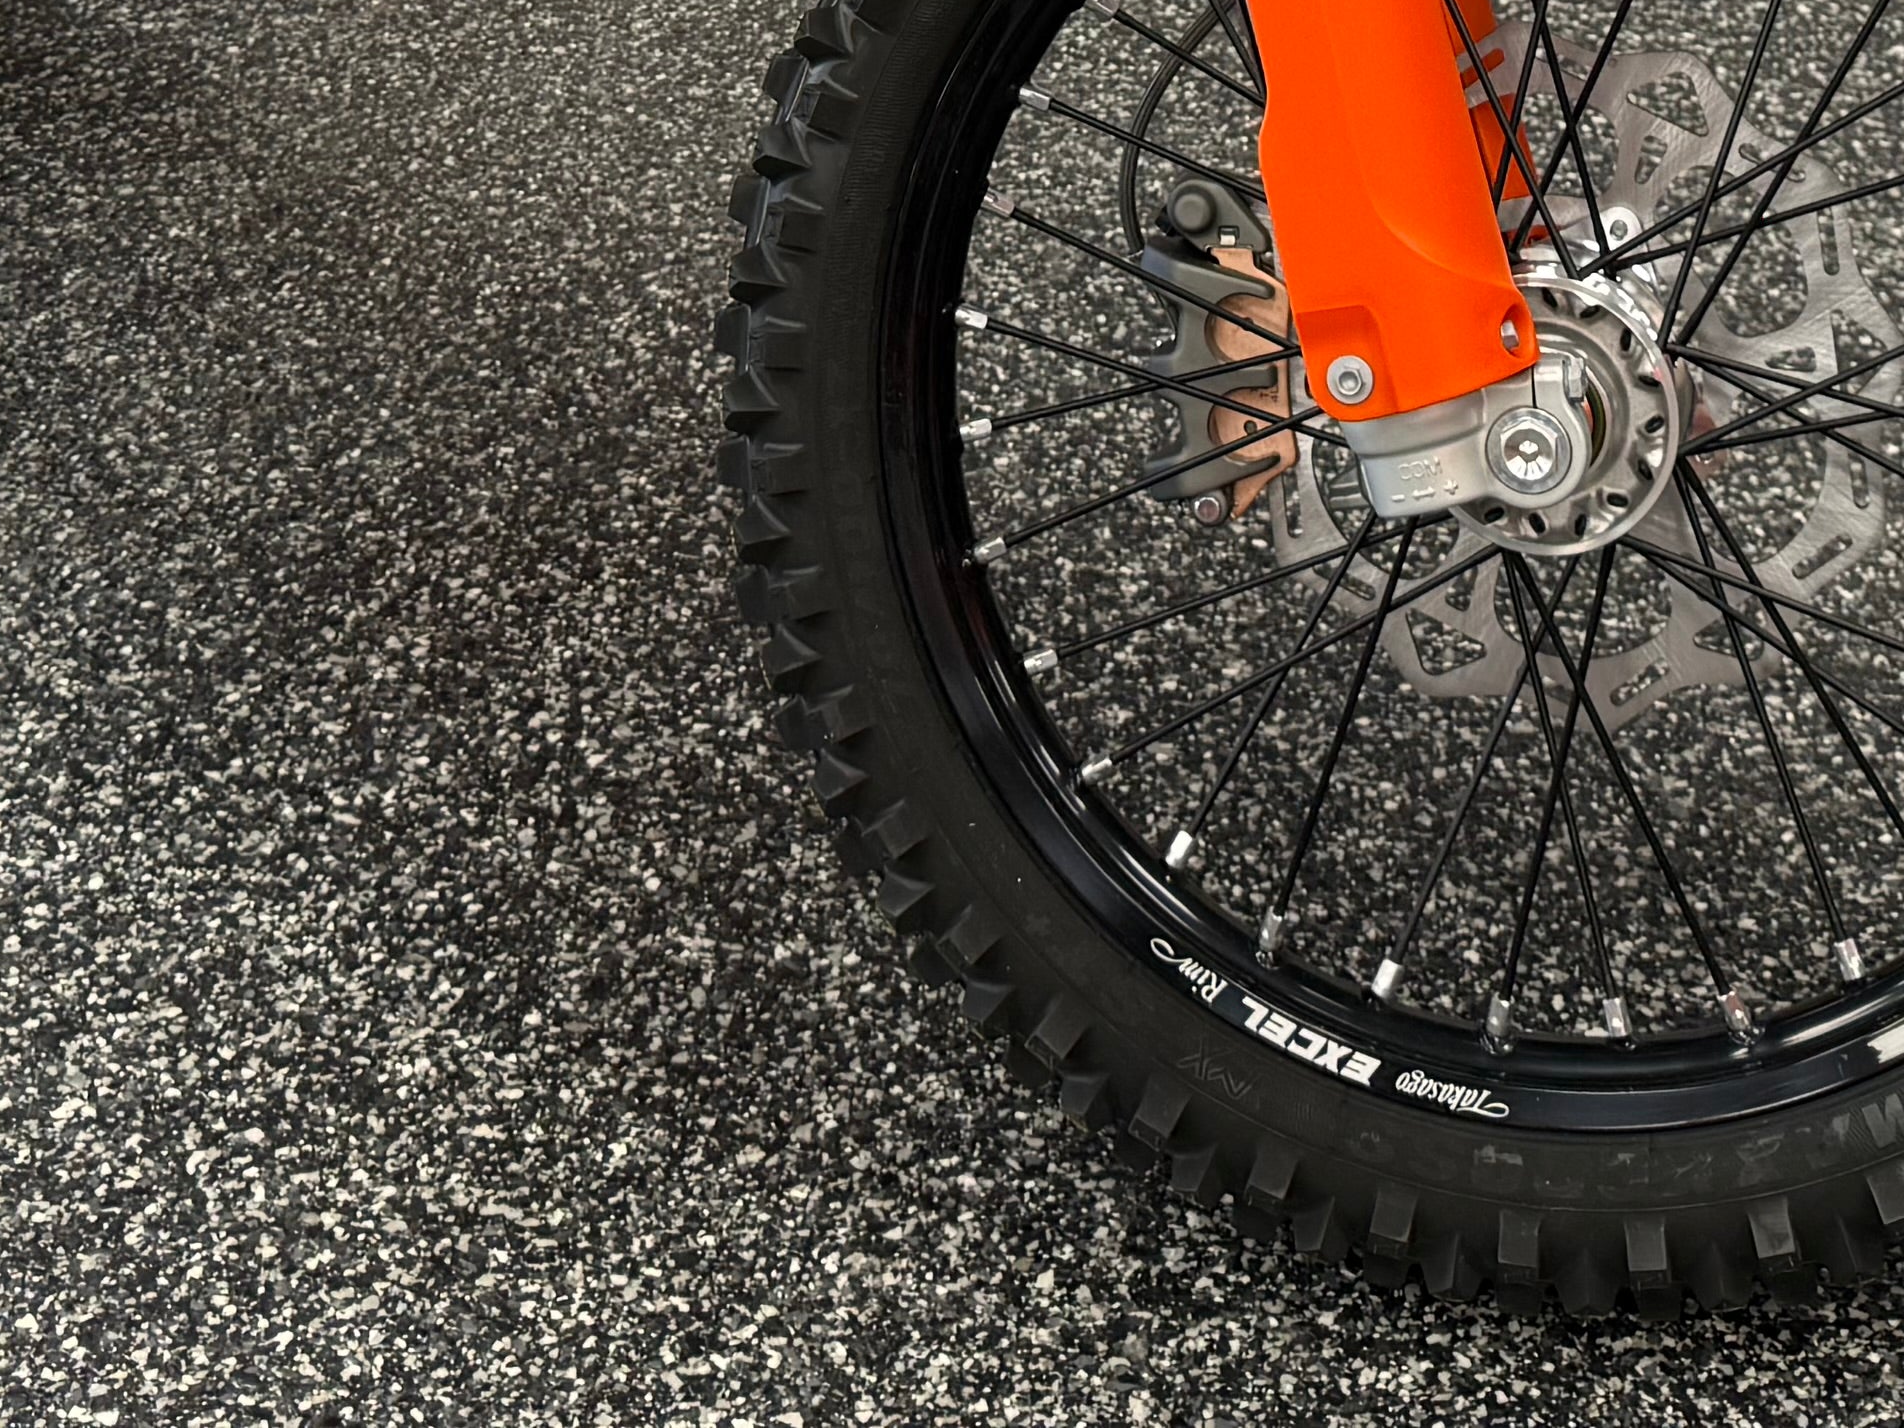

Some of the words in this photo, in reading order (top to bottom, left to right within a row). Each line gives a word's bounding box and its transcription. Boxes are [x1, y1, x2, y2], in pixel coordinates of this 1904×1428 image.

[1150, 936, 1229, 1005] Rim
[1241, 994, 1383, 1088] EXCEL
[1395, 1068, 1511, 1119] Takasago
